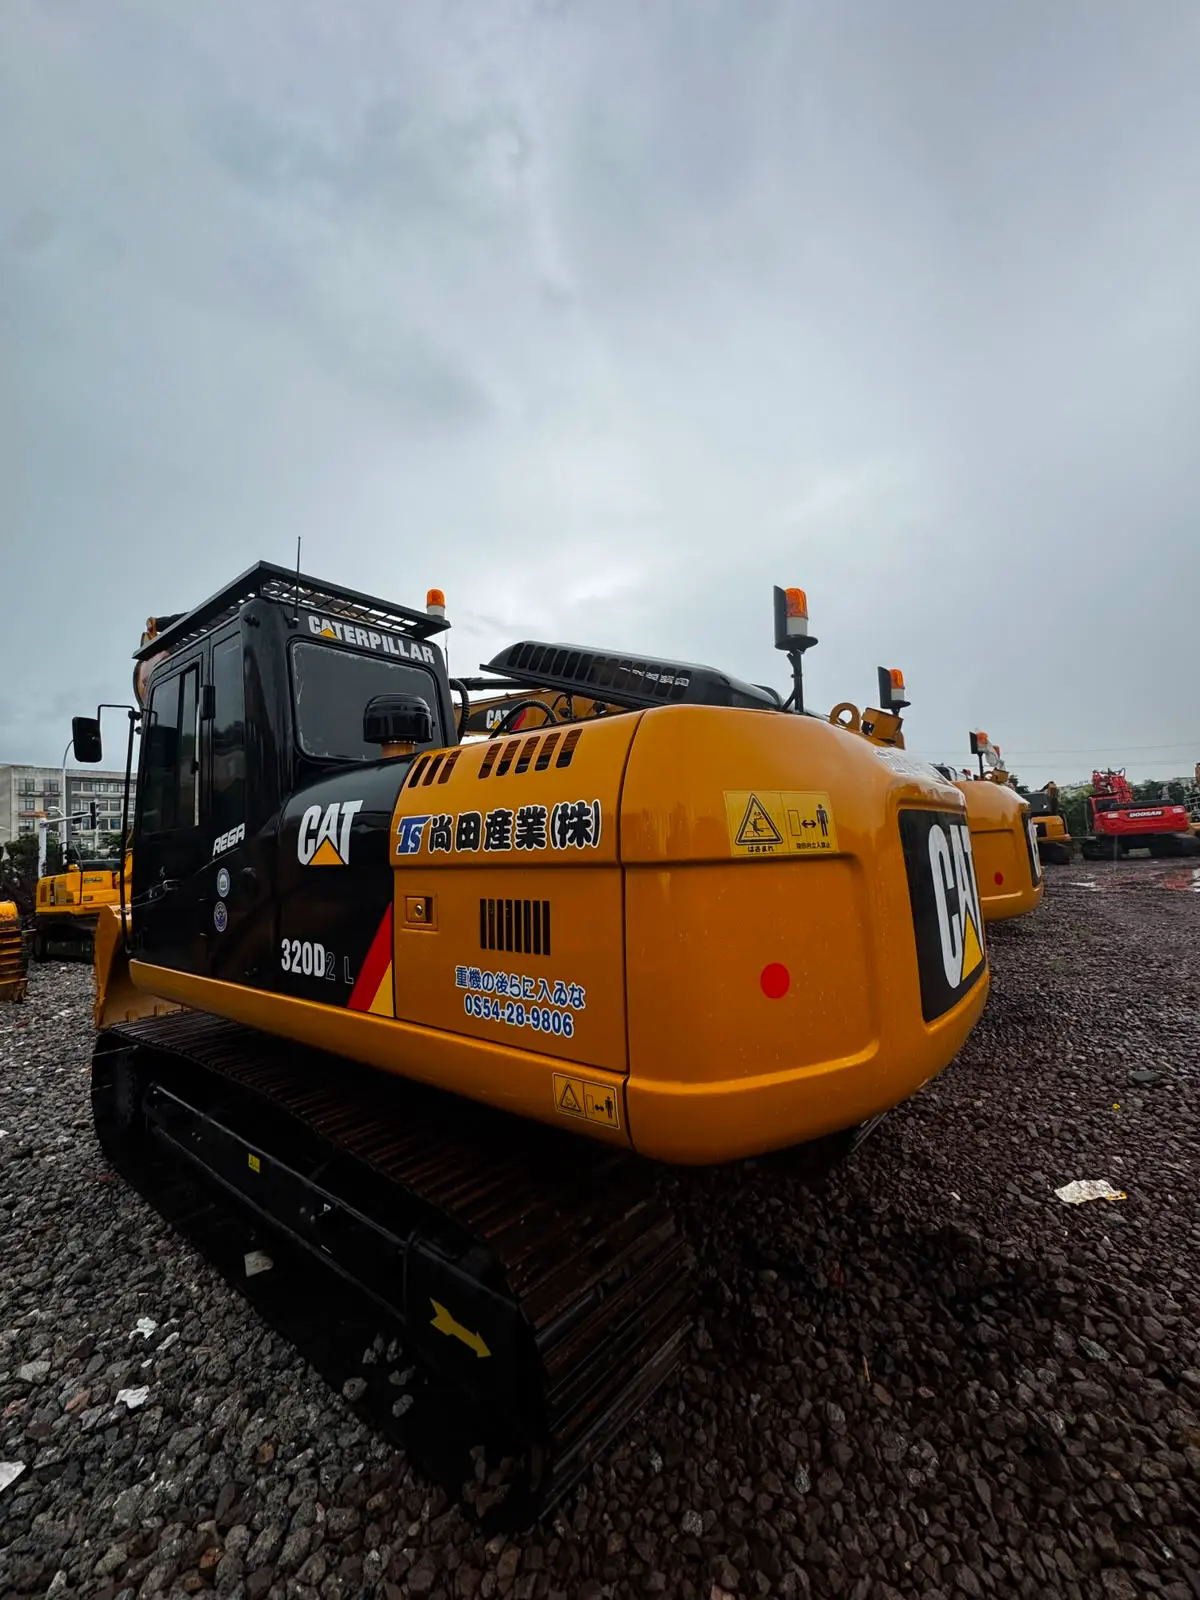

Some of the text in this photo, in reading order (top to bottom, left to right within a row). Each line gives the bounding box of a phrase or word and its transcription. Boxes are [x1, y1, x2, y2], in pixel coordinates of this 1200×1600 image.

[308, 615, 435, 664] CATERPILLAR
[212, 823, 246, 857] REGA
[297, 800, 363, 866] CAT
[428, 799, 601, 854] 尚田産業(株)
[1129, 810, 1163, 818] DOOSAN
[928, 823, 985, 989] CAT
